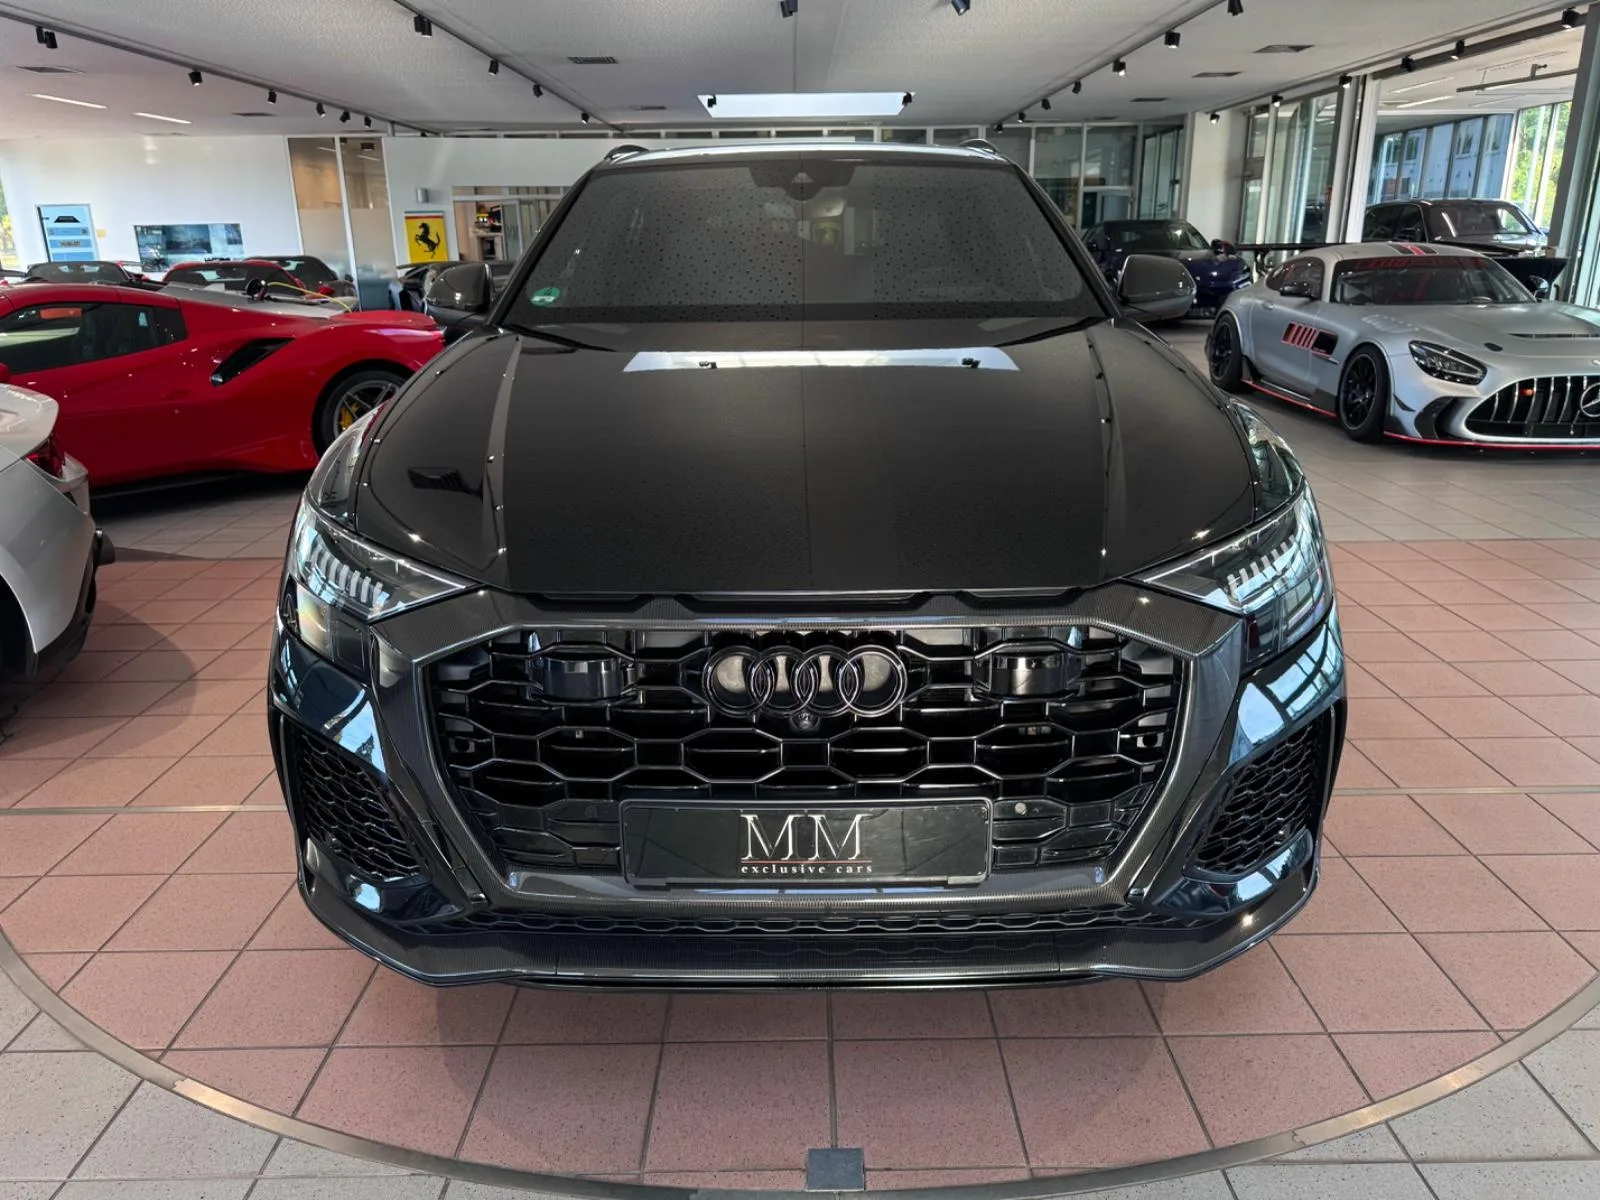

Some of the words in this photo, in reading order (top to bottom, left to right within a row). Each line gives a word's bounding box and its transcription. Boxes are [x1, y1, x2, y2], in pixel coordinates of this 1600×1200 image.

[741, 814, 872, 860] MM
[741, 864, 826, 874] exclusive
[836, 865, 873, 874] cars
